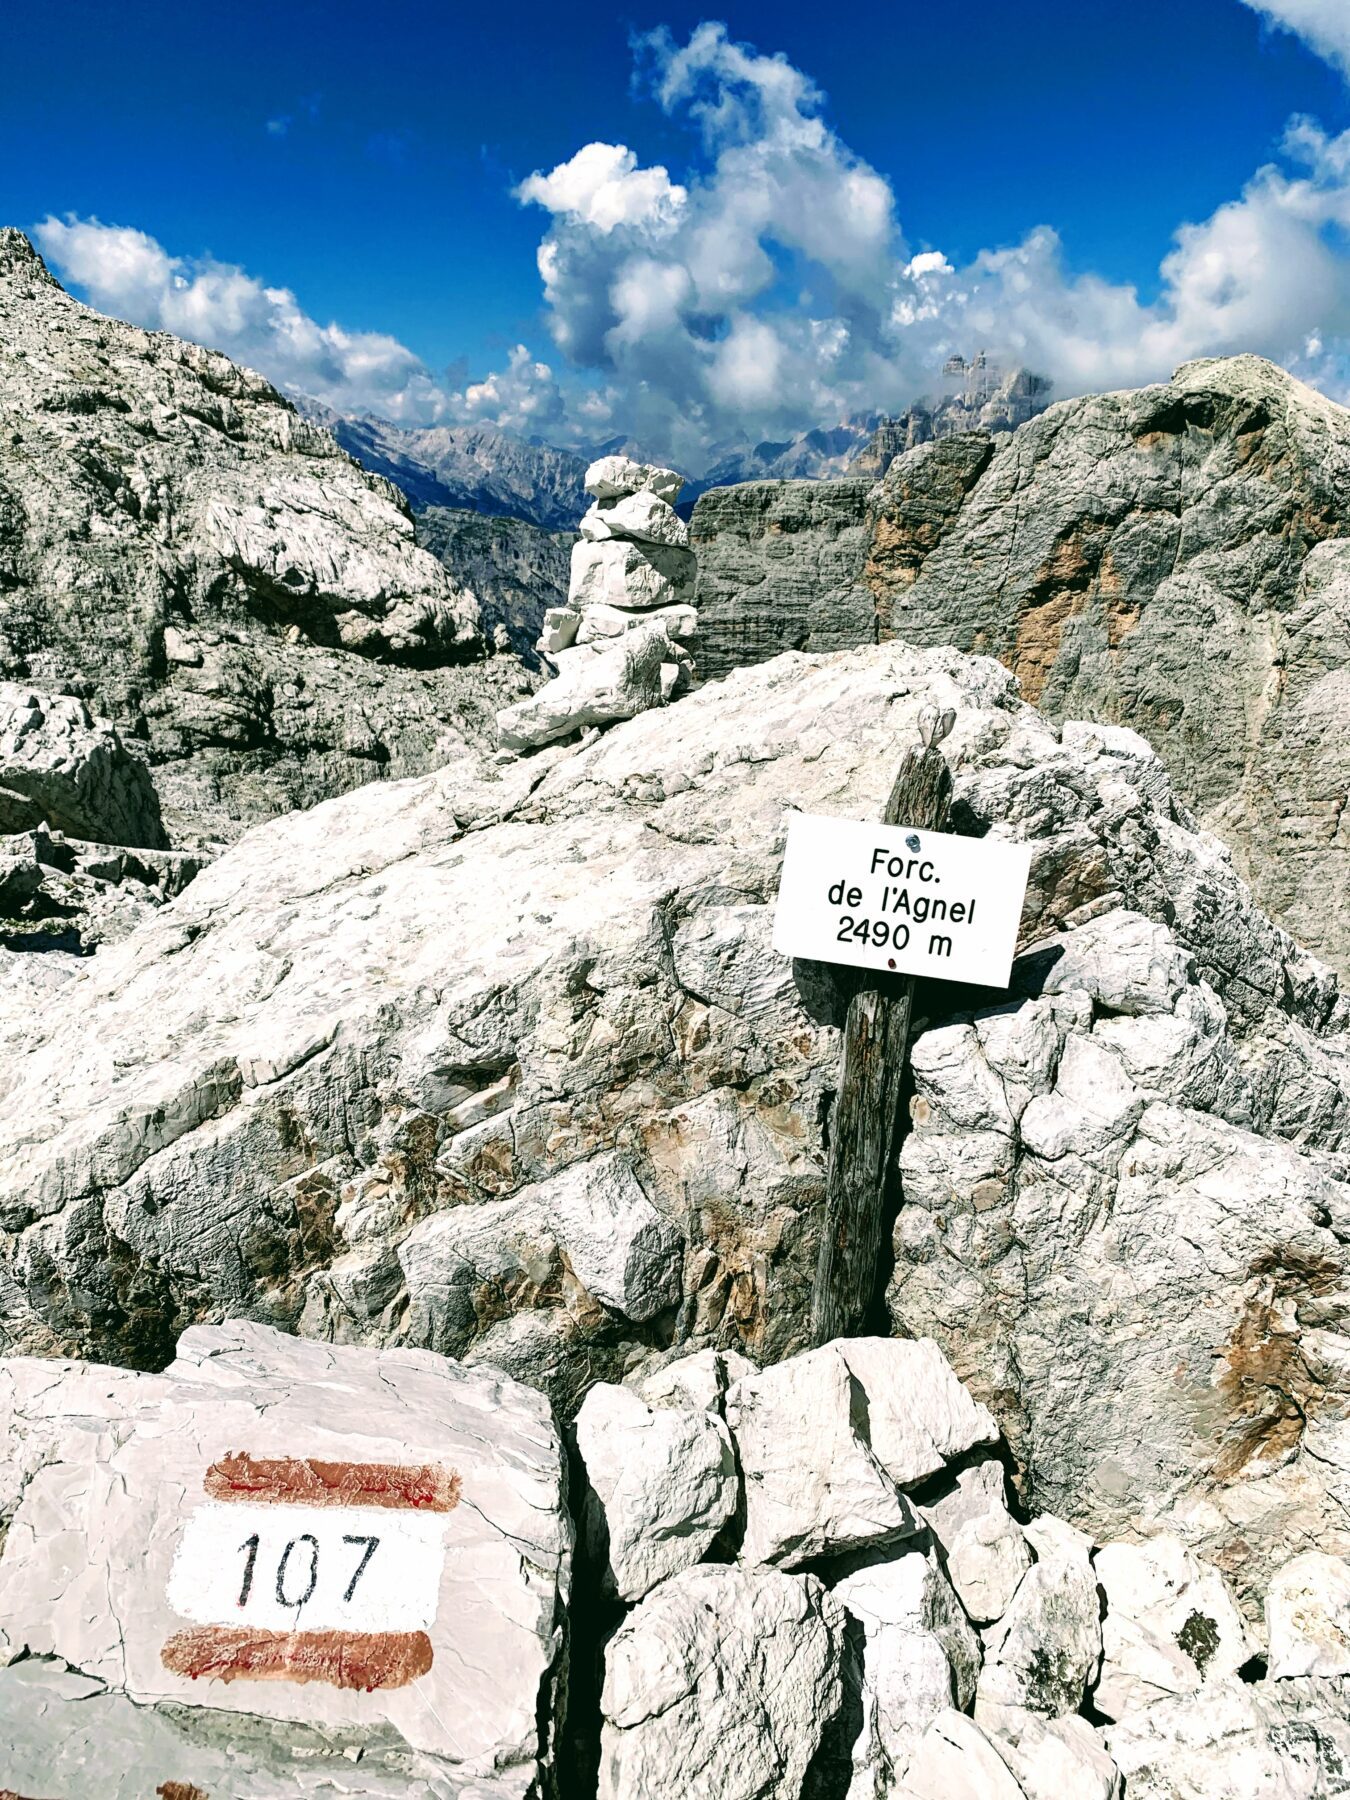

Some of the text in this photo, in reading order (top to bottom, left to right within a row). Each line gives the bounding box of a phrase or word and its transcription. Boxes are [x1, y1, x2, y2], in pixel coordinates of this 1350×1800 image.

[871, 848, 941, 884] Forc.
[828, 879, 976, 925] de l'Agnel
[836, 915, 953, 957] 2490 m
[237, 1533, 381, 1610] 107
